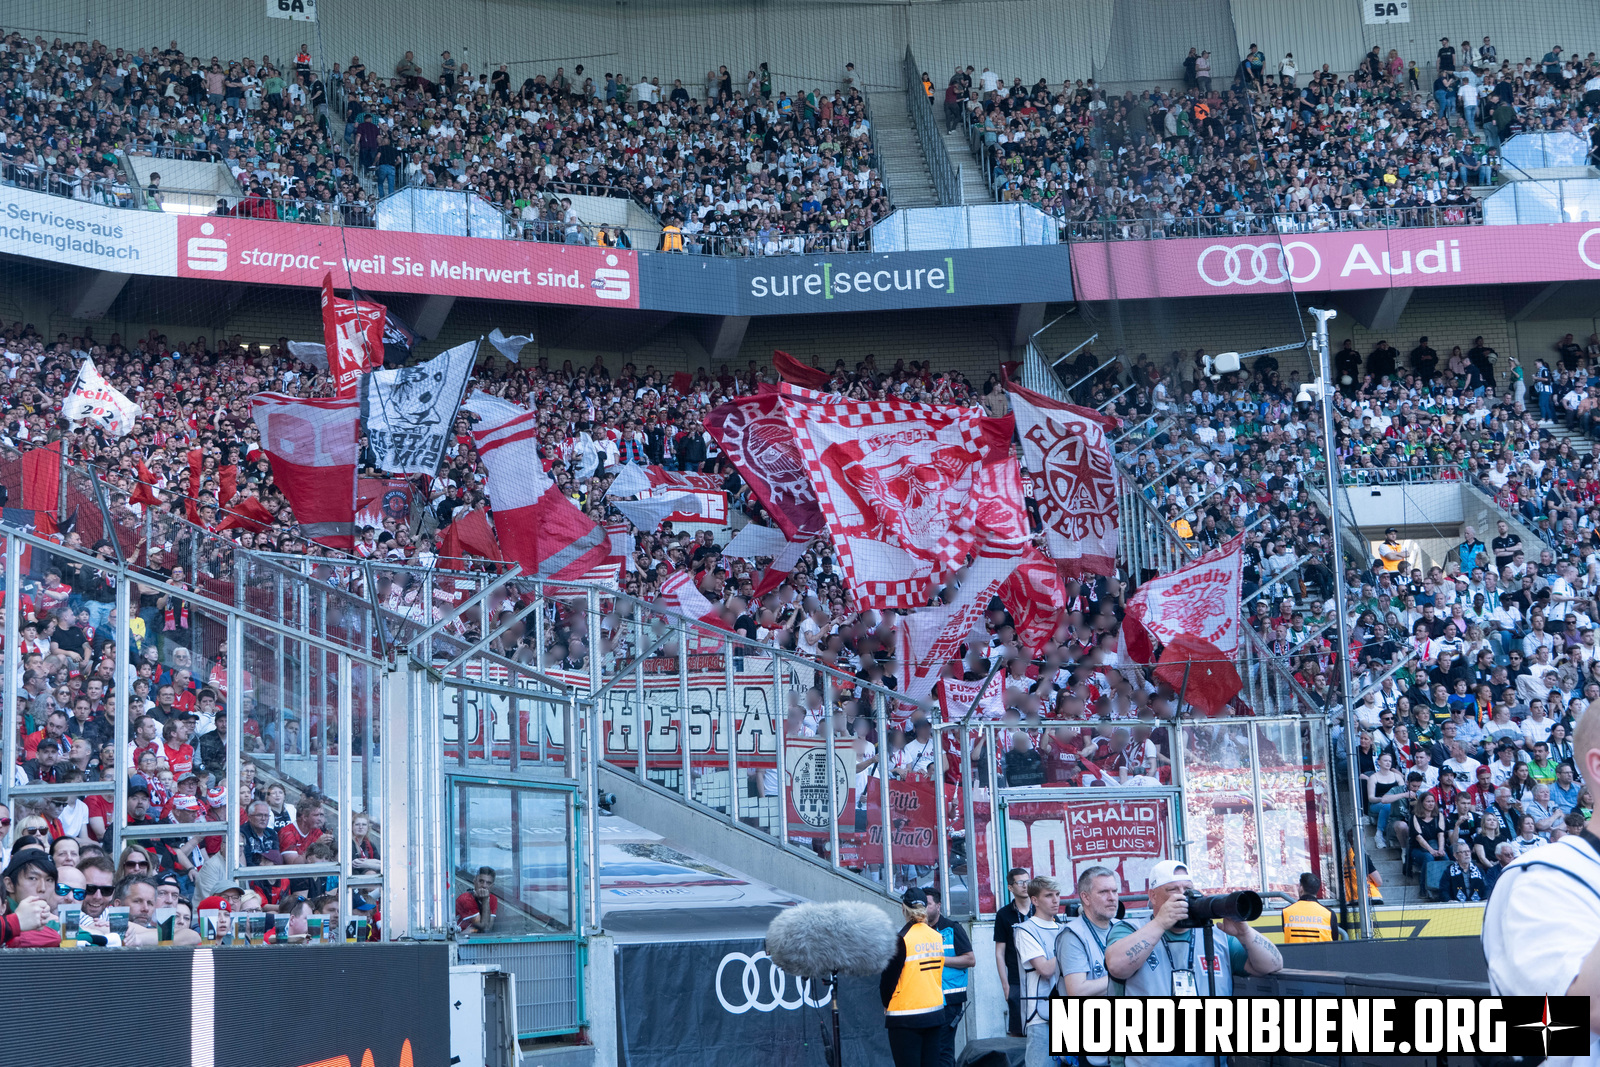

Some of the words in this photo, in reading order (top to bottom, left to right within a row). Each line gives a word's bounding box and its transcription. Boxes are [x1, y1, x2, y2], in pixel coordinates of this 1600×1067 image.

[1374, 3, 1398, 16] 5A
[0, 201, 86, 232] -Services
[91, 223, 123, 239] aus
[1340, 239, 1461, 277] Audi
[240, 247, 320, 272] starpac
[342, 254, 386, 275] weil
[391, 257, 425, 277] Sie
[430, 259, 532, 286] Mehrwert
[537, 268, 585, 289] sind.
[81, 405, 118, 431] 2024
[1022, 483, 1034, 498] 18
[953, 694, 975, 703] FÜR
[443, 678, 777, 753] SYNHESIA
[1070, 807, 1155, 826] KHALID
[869, 825, 934, 848] Nstra79
[1072, 825, 1103, 841] FÜR
[1107, 825, 1156, 837] IMMER
[1086, 841, 1109, 852] BEI
[1112, 838, 1145, 850] UNS
[1288, 914, 1323, 924] ORDNER
